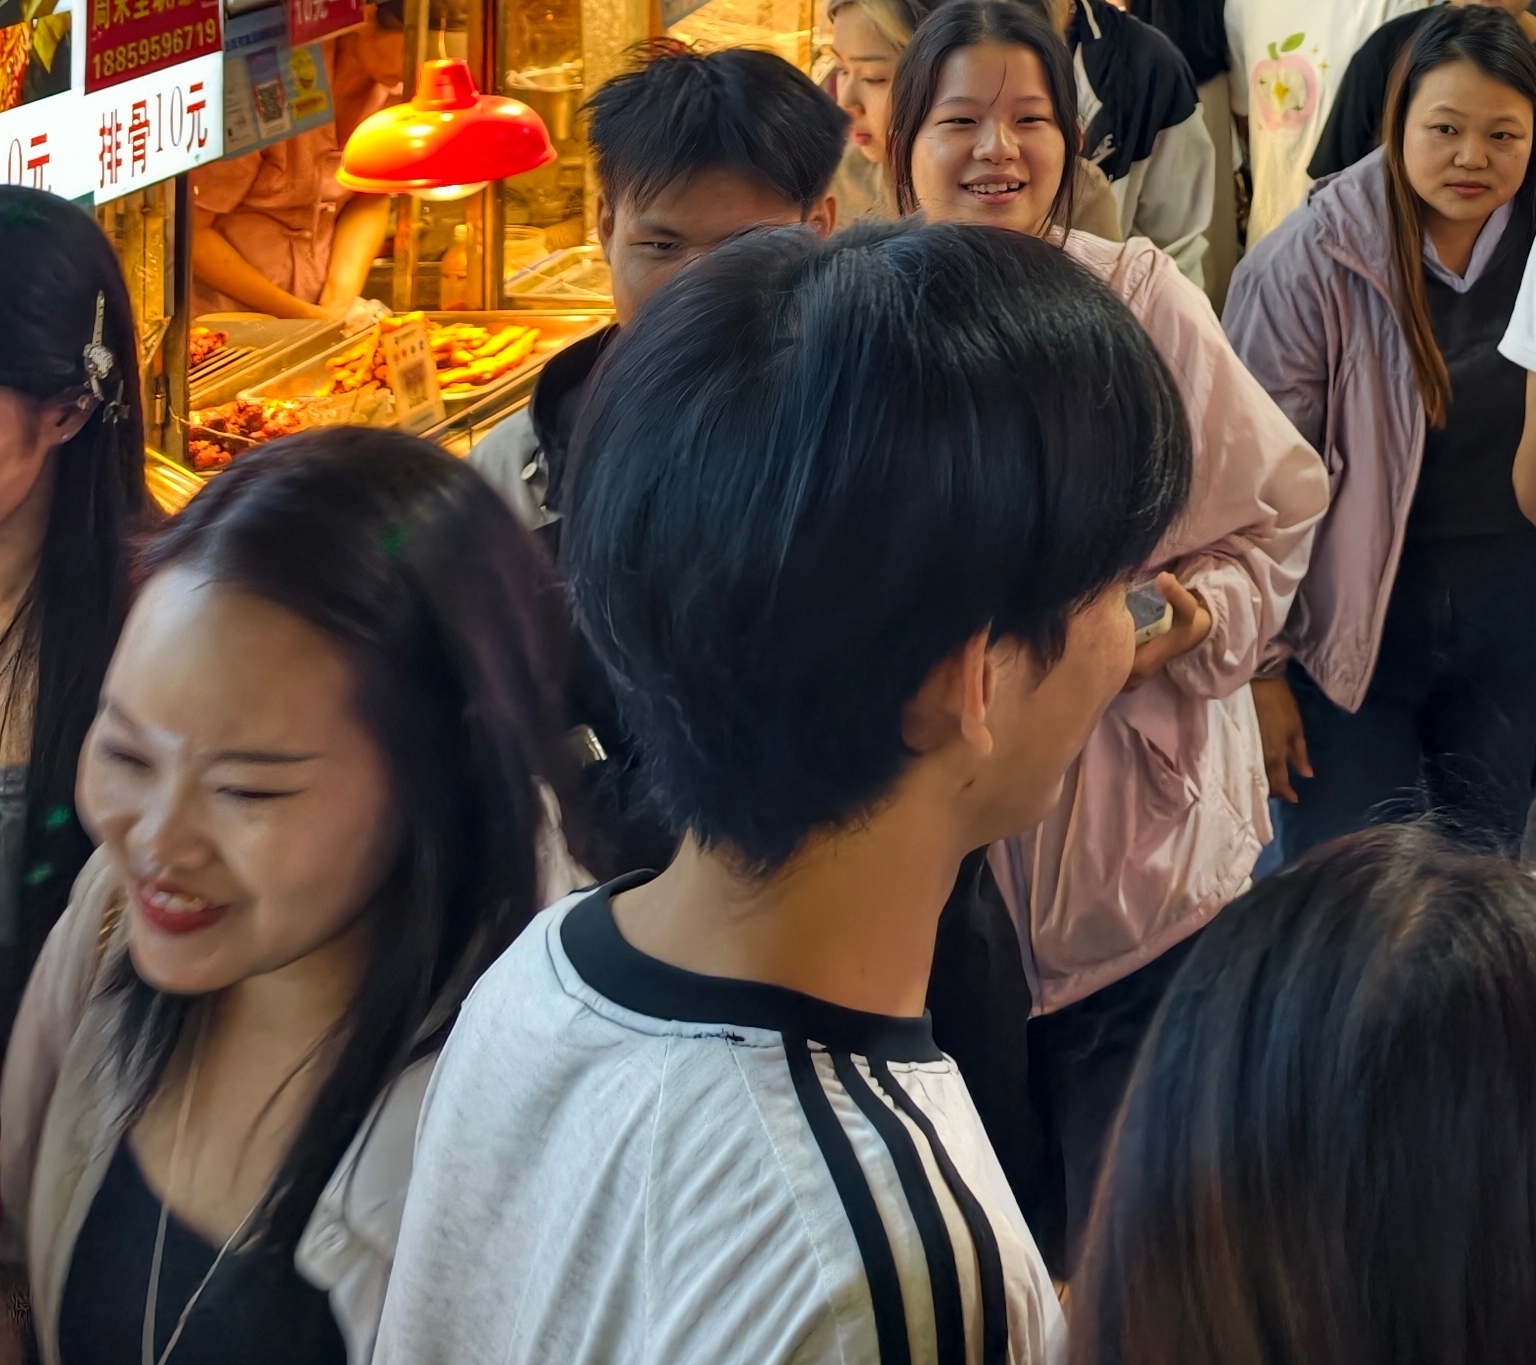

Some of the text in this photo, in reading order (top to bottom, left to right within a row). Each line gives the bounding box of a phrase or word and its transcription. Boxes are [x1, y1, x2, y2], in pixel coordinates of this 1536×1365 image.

[92, 18, 217, 80] 18859596719
[99, 81, 208, 188] 排骨10元
